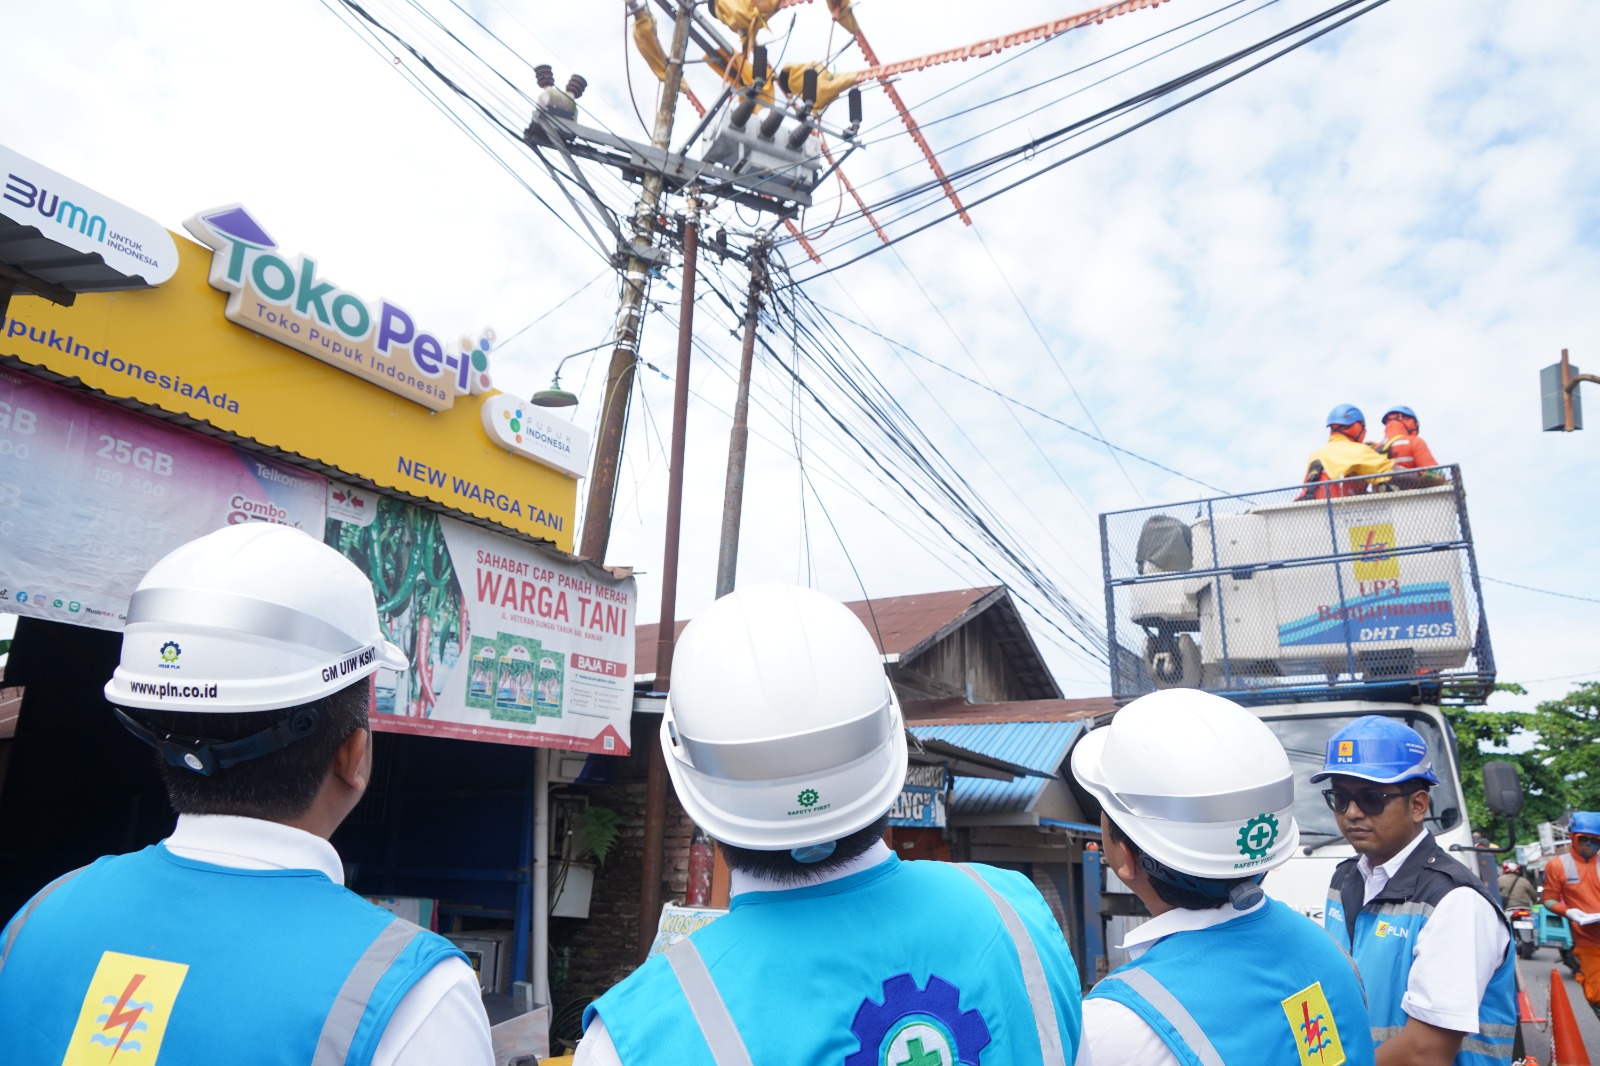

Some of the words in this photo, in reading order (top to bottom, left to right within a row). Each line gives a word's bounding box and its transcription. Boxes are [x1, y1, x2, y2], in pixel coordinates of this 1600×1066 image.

[109, 230, 143, 251] UNTUK
[107, 240, 159, 268] INDONESIA
[256, 303, 300, 334] Toko
[309, 328, 362, 364] Pupuk
[370, 356, 446, 401] Indonesia
[526, 417, 572, 444] PUPUK
[526, 427, 571, 454] INDONESIA
[96, 434, 174, 477] 25GB
[256, 462, 320, 499] Telkomsel
[397, 456, 447, 489] NEW
[452, 476, 522, 517] WARGA
[527, 504, 564, 532] TANI
[231, 496, 286, 519] Combo
[476, 550, 530, 577] SAHABAT
[533, 566, 554, 583] CAP
[558, 574, 592, 595] PANAH
[595, 585, 628, 605] MERAH
[1359, 579, 1400, 597] UP3
[476, 568, 570, 623] WARGA
[577, 596, 627, 637] TANI
[1317, 597, 1451, 623] Banjarmasin
[510, 614, 534, 627] VETERAN
[1359, 626, 1401, 641] DHT
[1406, 622, 1454, 638] 150S
[321, 664, 339, 683] GM
[340, 658, 358, 676] UIW
[577, 656, 603, 672] BAJA
[605, 662, 617, 675] F1
[130, 680, 218, 699] www.pln.co.id
[787, 807, 812, 816] SAFETY
[813, 803, 831, 812] FIRST
[1233, 860, 1260, 869] SAFETY
[1260, 853, 1277, 865] FIRST
[661, 913, 693, 935] KIOS
[1387, 926, 1409, 939] PLN
